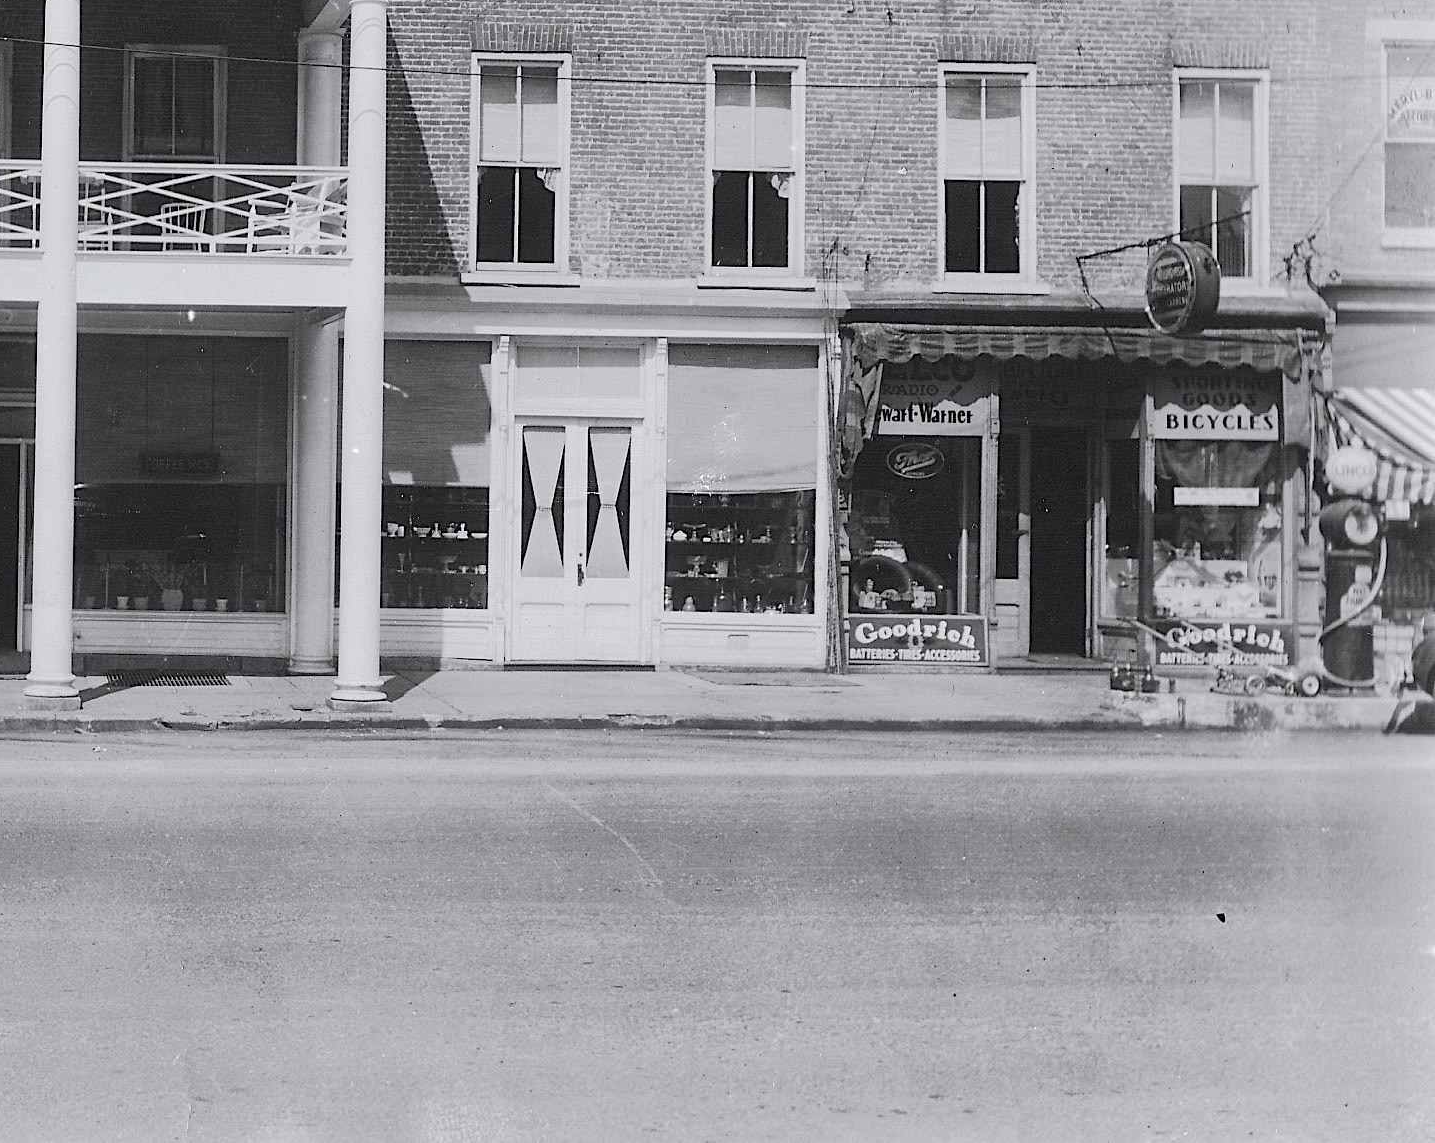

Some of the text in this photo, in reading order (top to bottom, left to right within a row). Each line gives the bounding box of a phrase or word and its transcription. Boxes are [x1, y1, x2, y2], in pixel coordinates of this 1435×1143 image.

[1182, 392, 1257, 407] GOODS
[1166, 414, 1274, 430] BICYCLES
[855, 618, 975, 648] Goodrich
[1166, 621, 1284, 653] Goodrich
